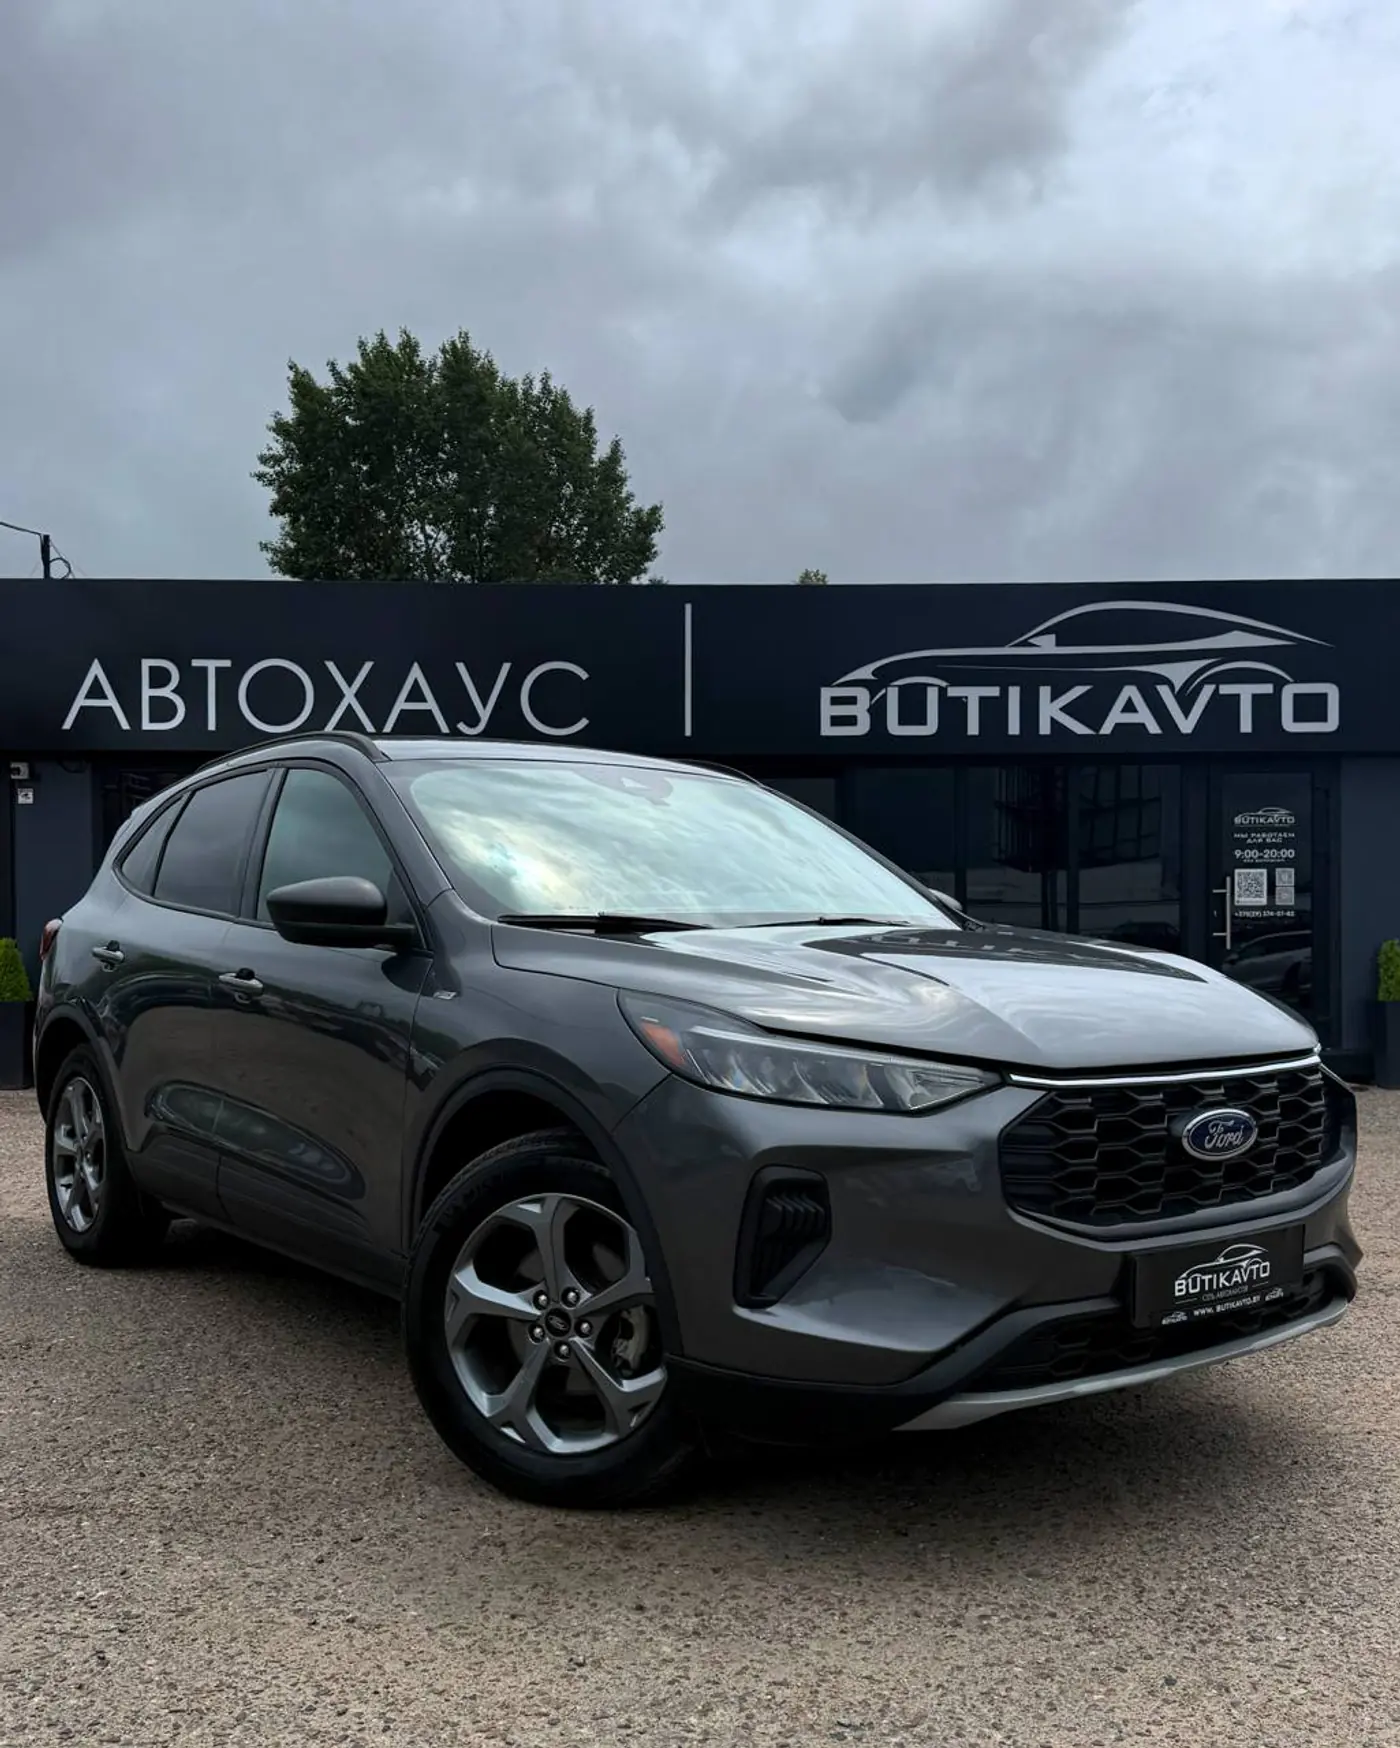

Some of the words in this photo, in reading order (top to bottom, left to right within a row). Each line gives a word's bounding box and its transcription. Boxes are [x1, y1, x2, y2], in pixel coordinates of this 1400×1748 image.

[61, 657, 590, 737] АВТОХАУС
[819, 682, 1340, 736] BUTIKAVTO
[1234, 815, 1295, 824] BUTIKAVTO
[1234, 849, 1295, 859] 9:00-20:00
[1204, 1120, 1244, 1149] Ford
[1174, 1261, 1270, 1296] BUTIKAVTO
